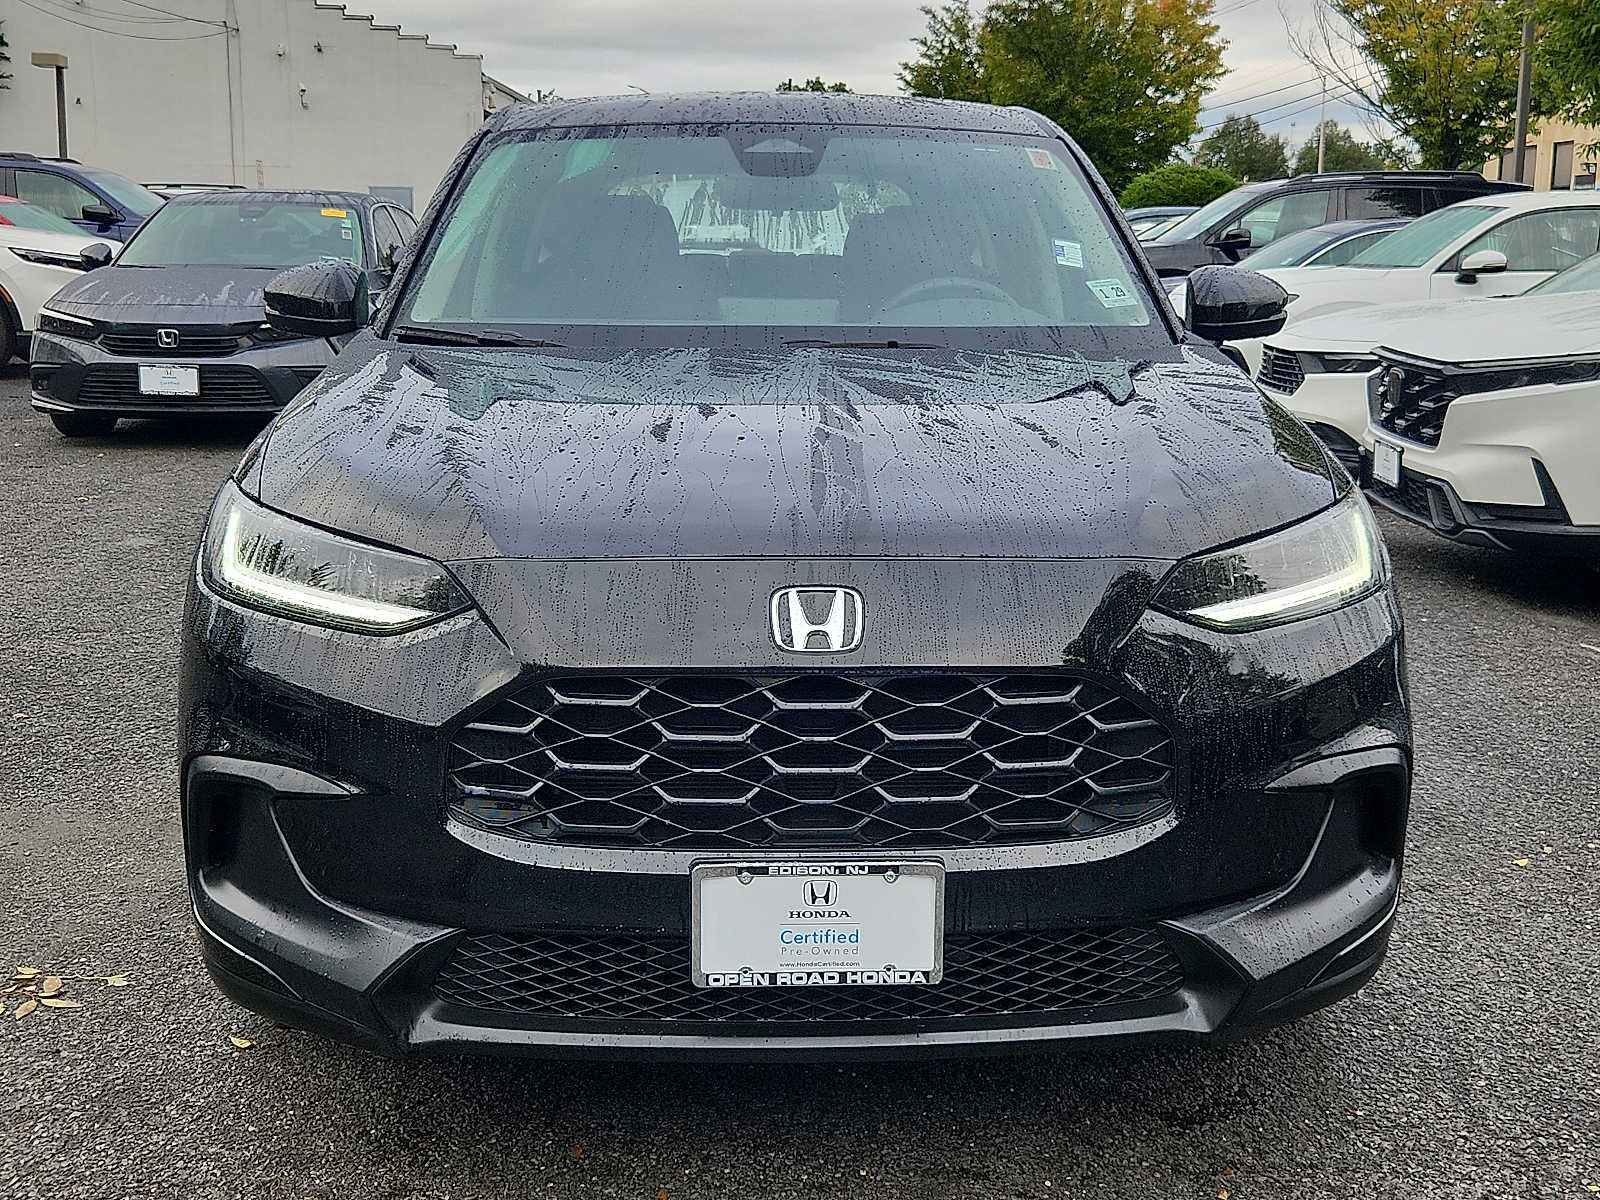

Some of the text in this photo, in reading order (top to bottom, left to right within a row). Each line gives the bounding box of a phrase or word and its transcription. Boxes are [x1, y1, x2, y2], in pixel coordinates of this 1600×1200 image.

[1099, 286, 1126, 298] 1 29
[768, 866, 869, 876] EDISON, NJ
[788, 910, 852, 919] HONDA
[780, 928, 860, 945] Certified
[780, 946, 860, 956] Pre-Owned
[708, 971, 928, 986] OPEN ROAD HONDA
